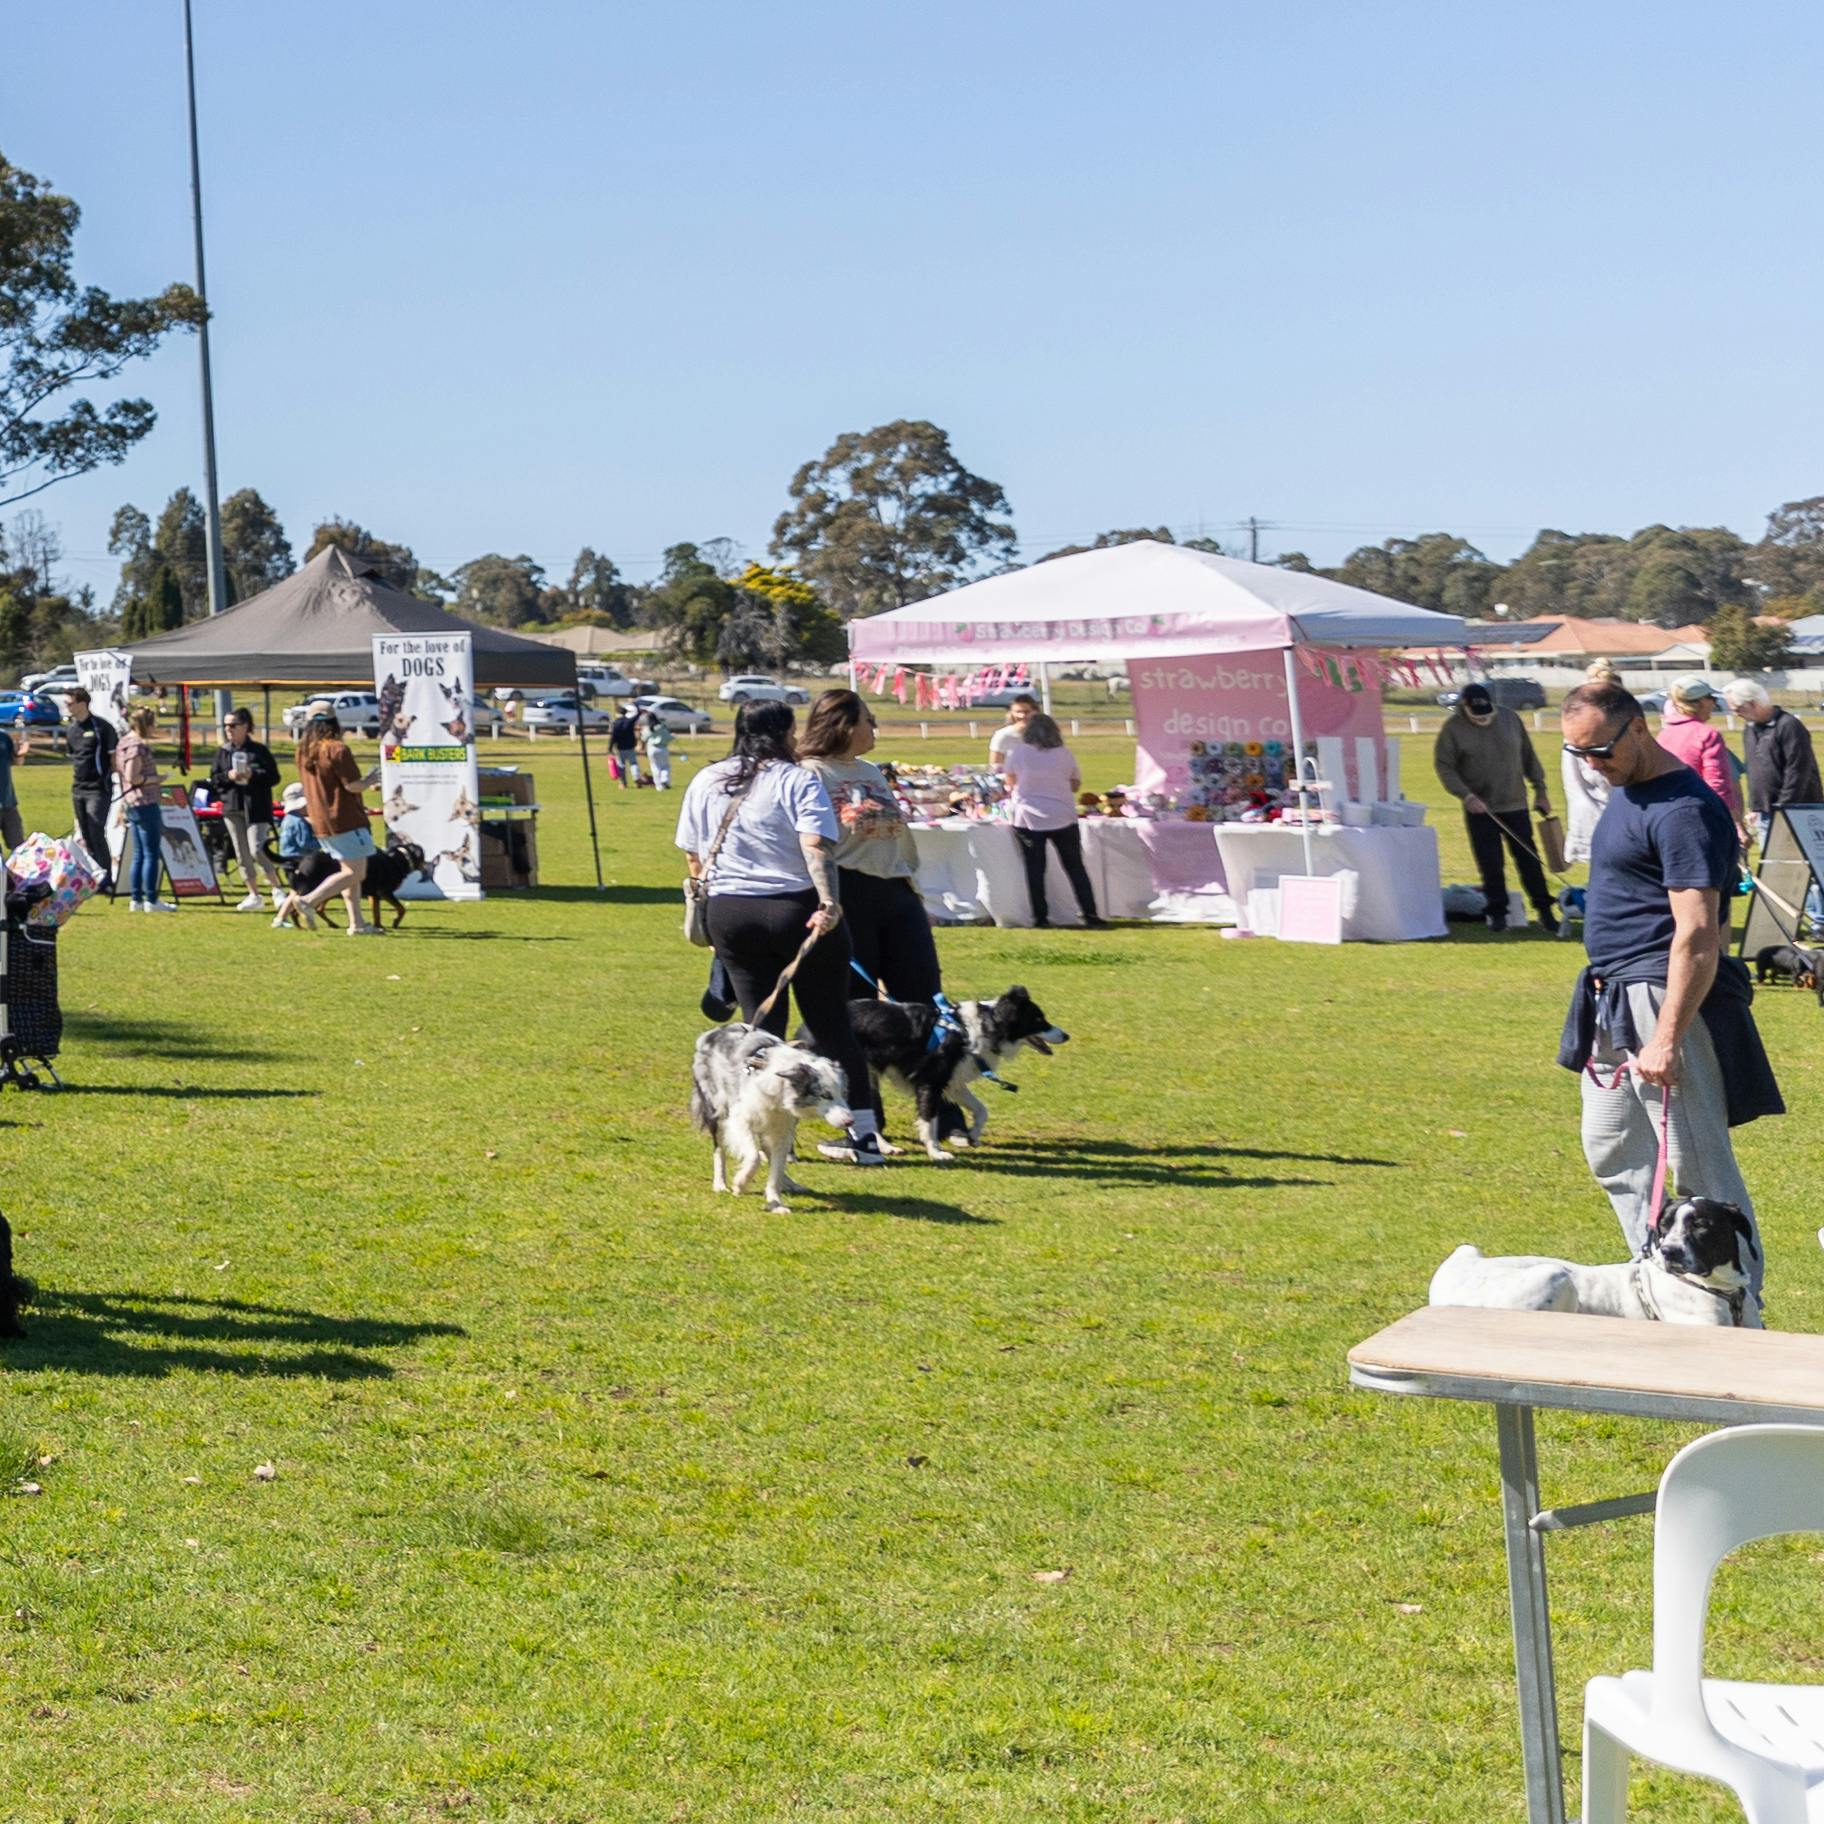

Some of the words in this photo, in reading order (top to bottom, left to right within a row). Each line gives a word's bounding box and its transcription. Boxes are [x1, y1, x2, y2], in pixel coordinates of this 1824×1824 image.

[380, 641, 399, 654] For
[403, 640, 421, 653] the
[425, 639, 449, 653] love
[453, 639, 465, 652] of
[402, 657, 445, 677] DOGS
[1139, 665, 1287, 698] strawberry
[1163, 708, 1250, 740] design
[1259, 716, 1288, 736] co
